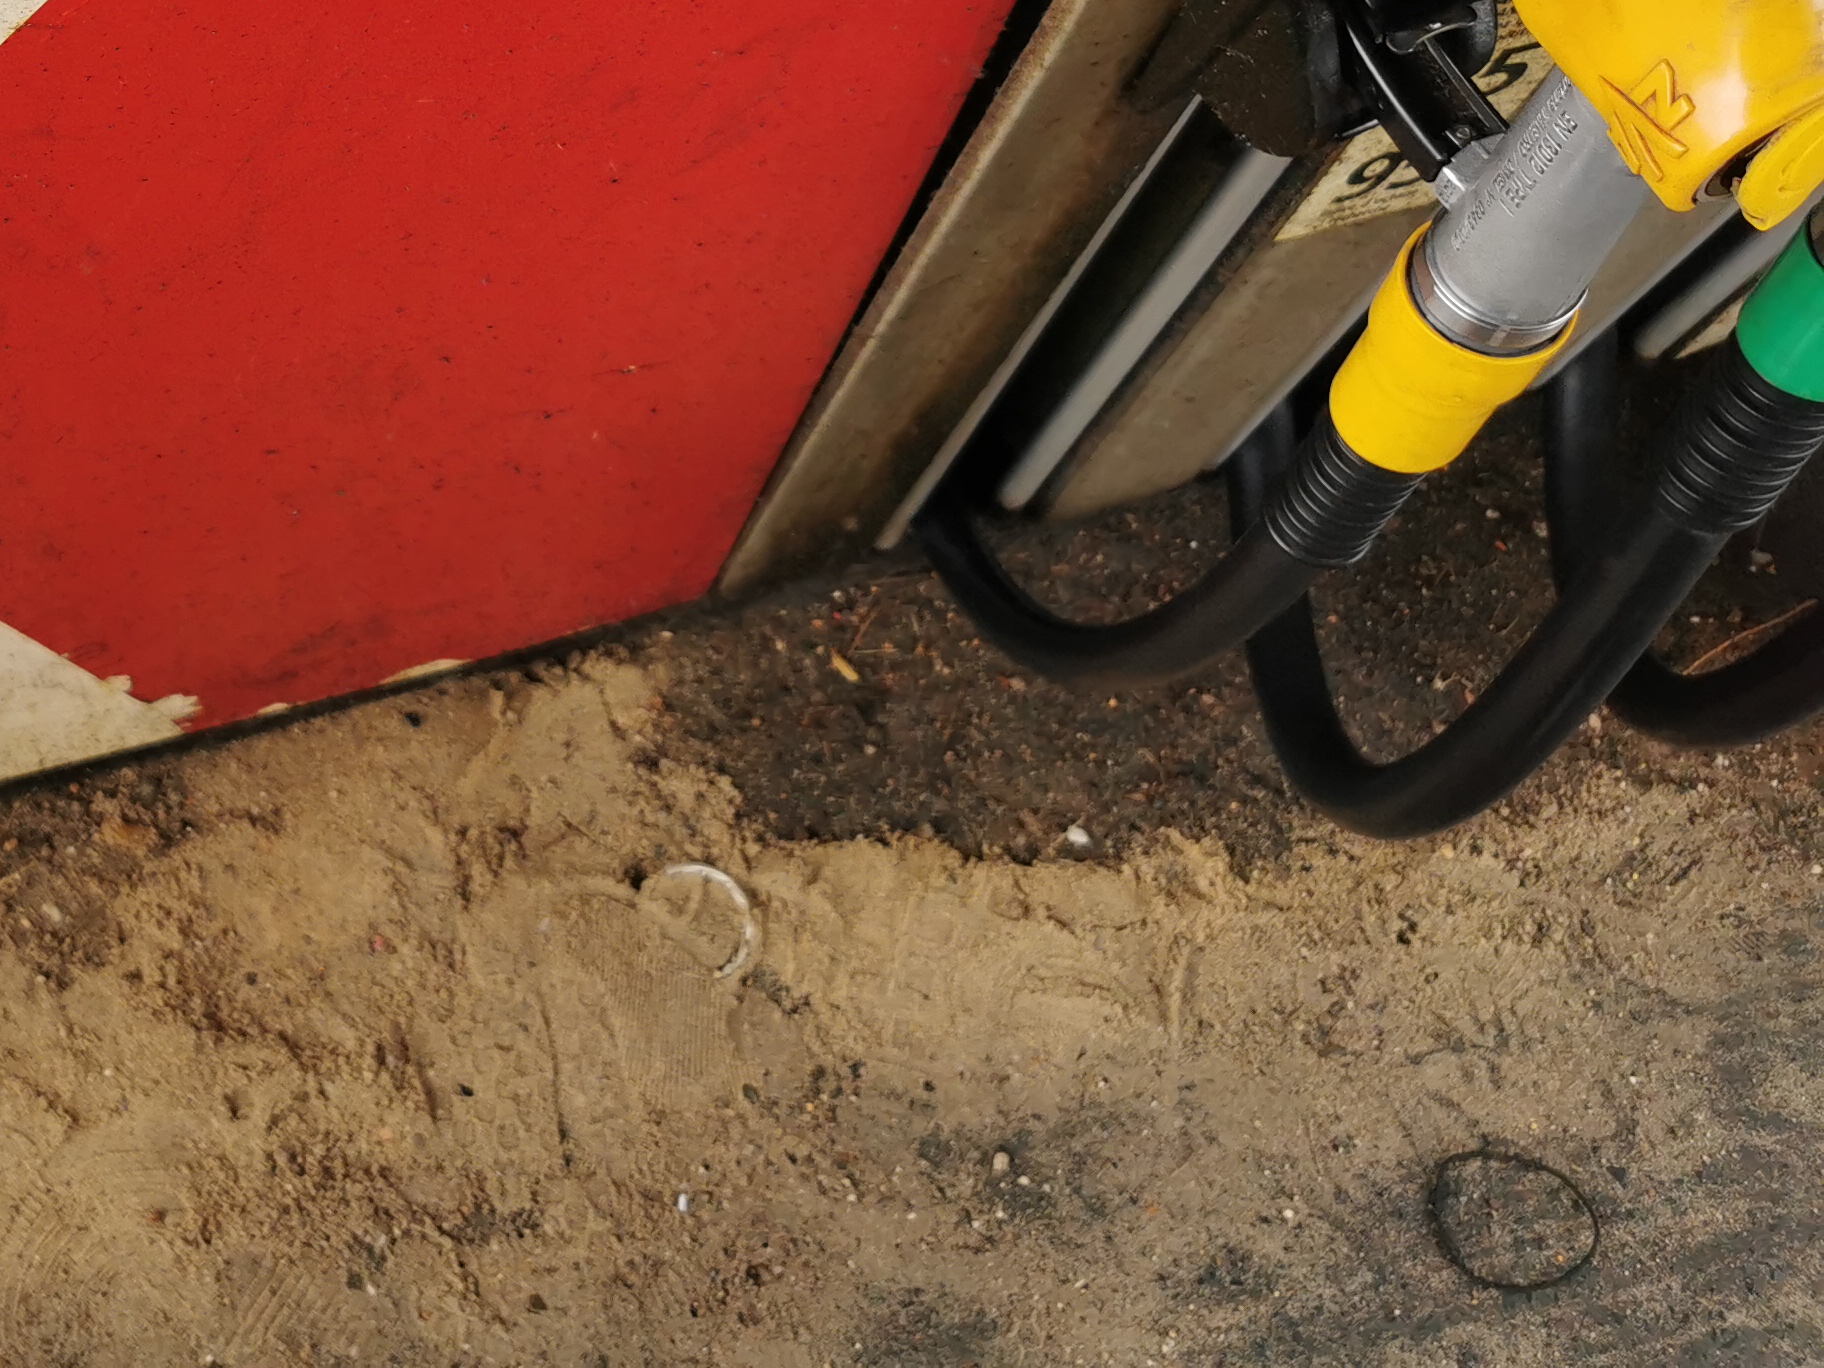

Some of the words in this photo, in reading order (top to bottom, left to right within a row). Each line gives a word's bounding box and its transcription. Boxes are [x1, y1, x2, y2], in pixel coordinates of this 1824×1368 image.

[1552, 110, 1578, 141] EN
[1528, 132, 1562, 176] 13012
[1505, 169, 1537, 208] TYPE
